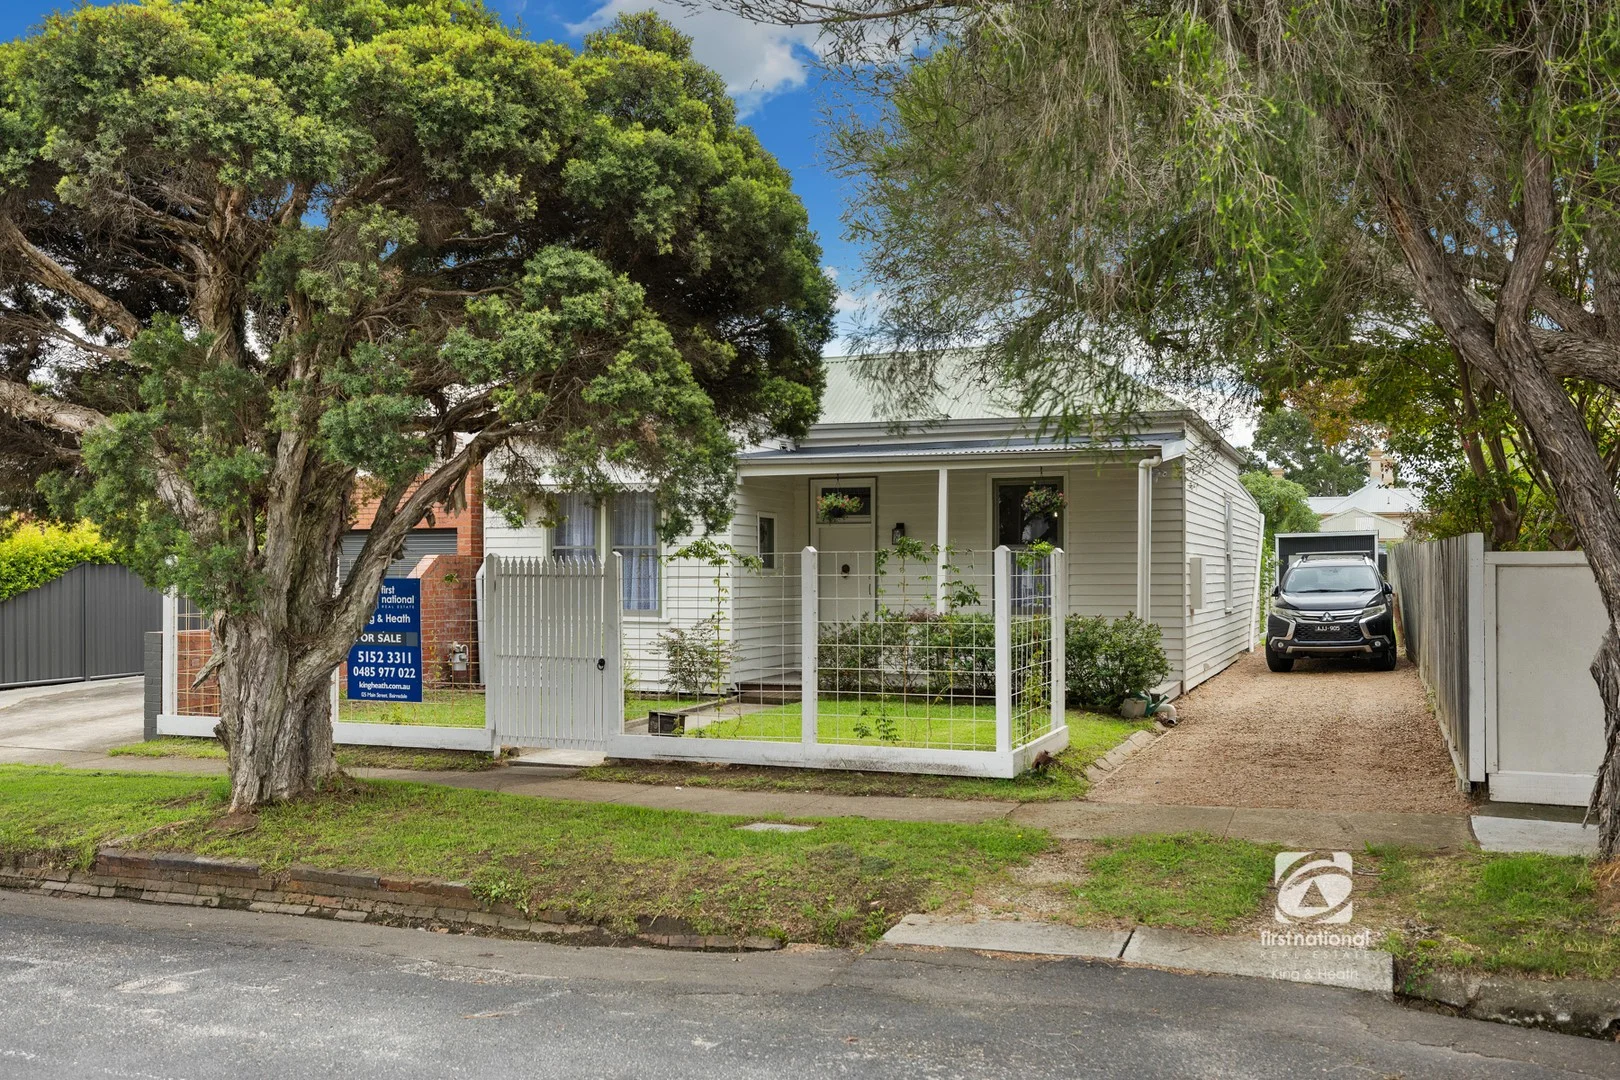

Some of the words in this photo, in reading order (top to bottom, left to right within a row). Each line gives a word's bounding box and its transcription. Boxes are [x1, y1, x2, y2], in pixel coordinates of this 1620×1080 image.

[381, 585, 395, 594] first
[381, 595, 414, 604] national
[377, 614, 384, 622] &
[385, 614, 410, 622] Heath
[356, 634, 374, 642] OR
[378, 634, 402, 642] SALE
[358, 651, 384, 663] 5152
[387, 651, 412, 664] 3311
[353, 666, 376, 677] 0485
[378, 667, 395, 677] 977
[398, 668, 416, 678] 022
[359, 681, 411, 690] kingheath.com.au
